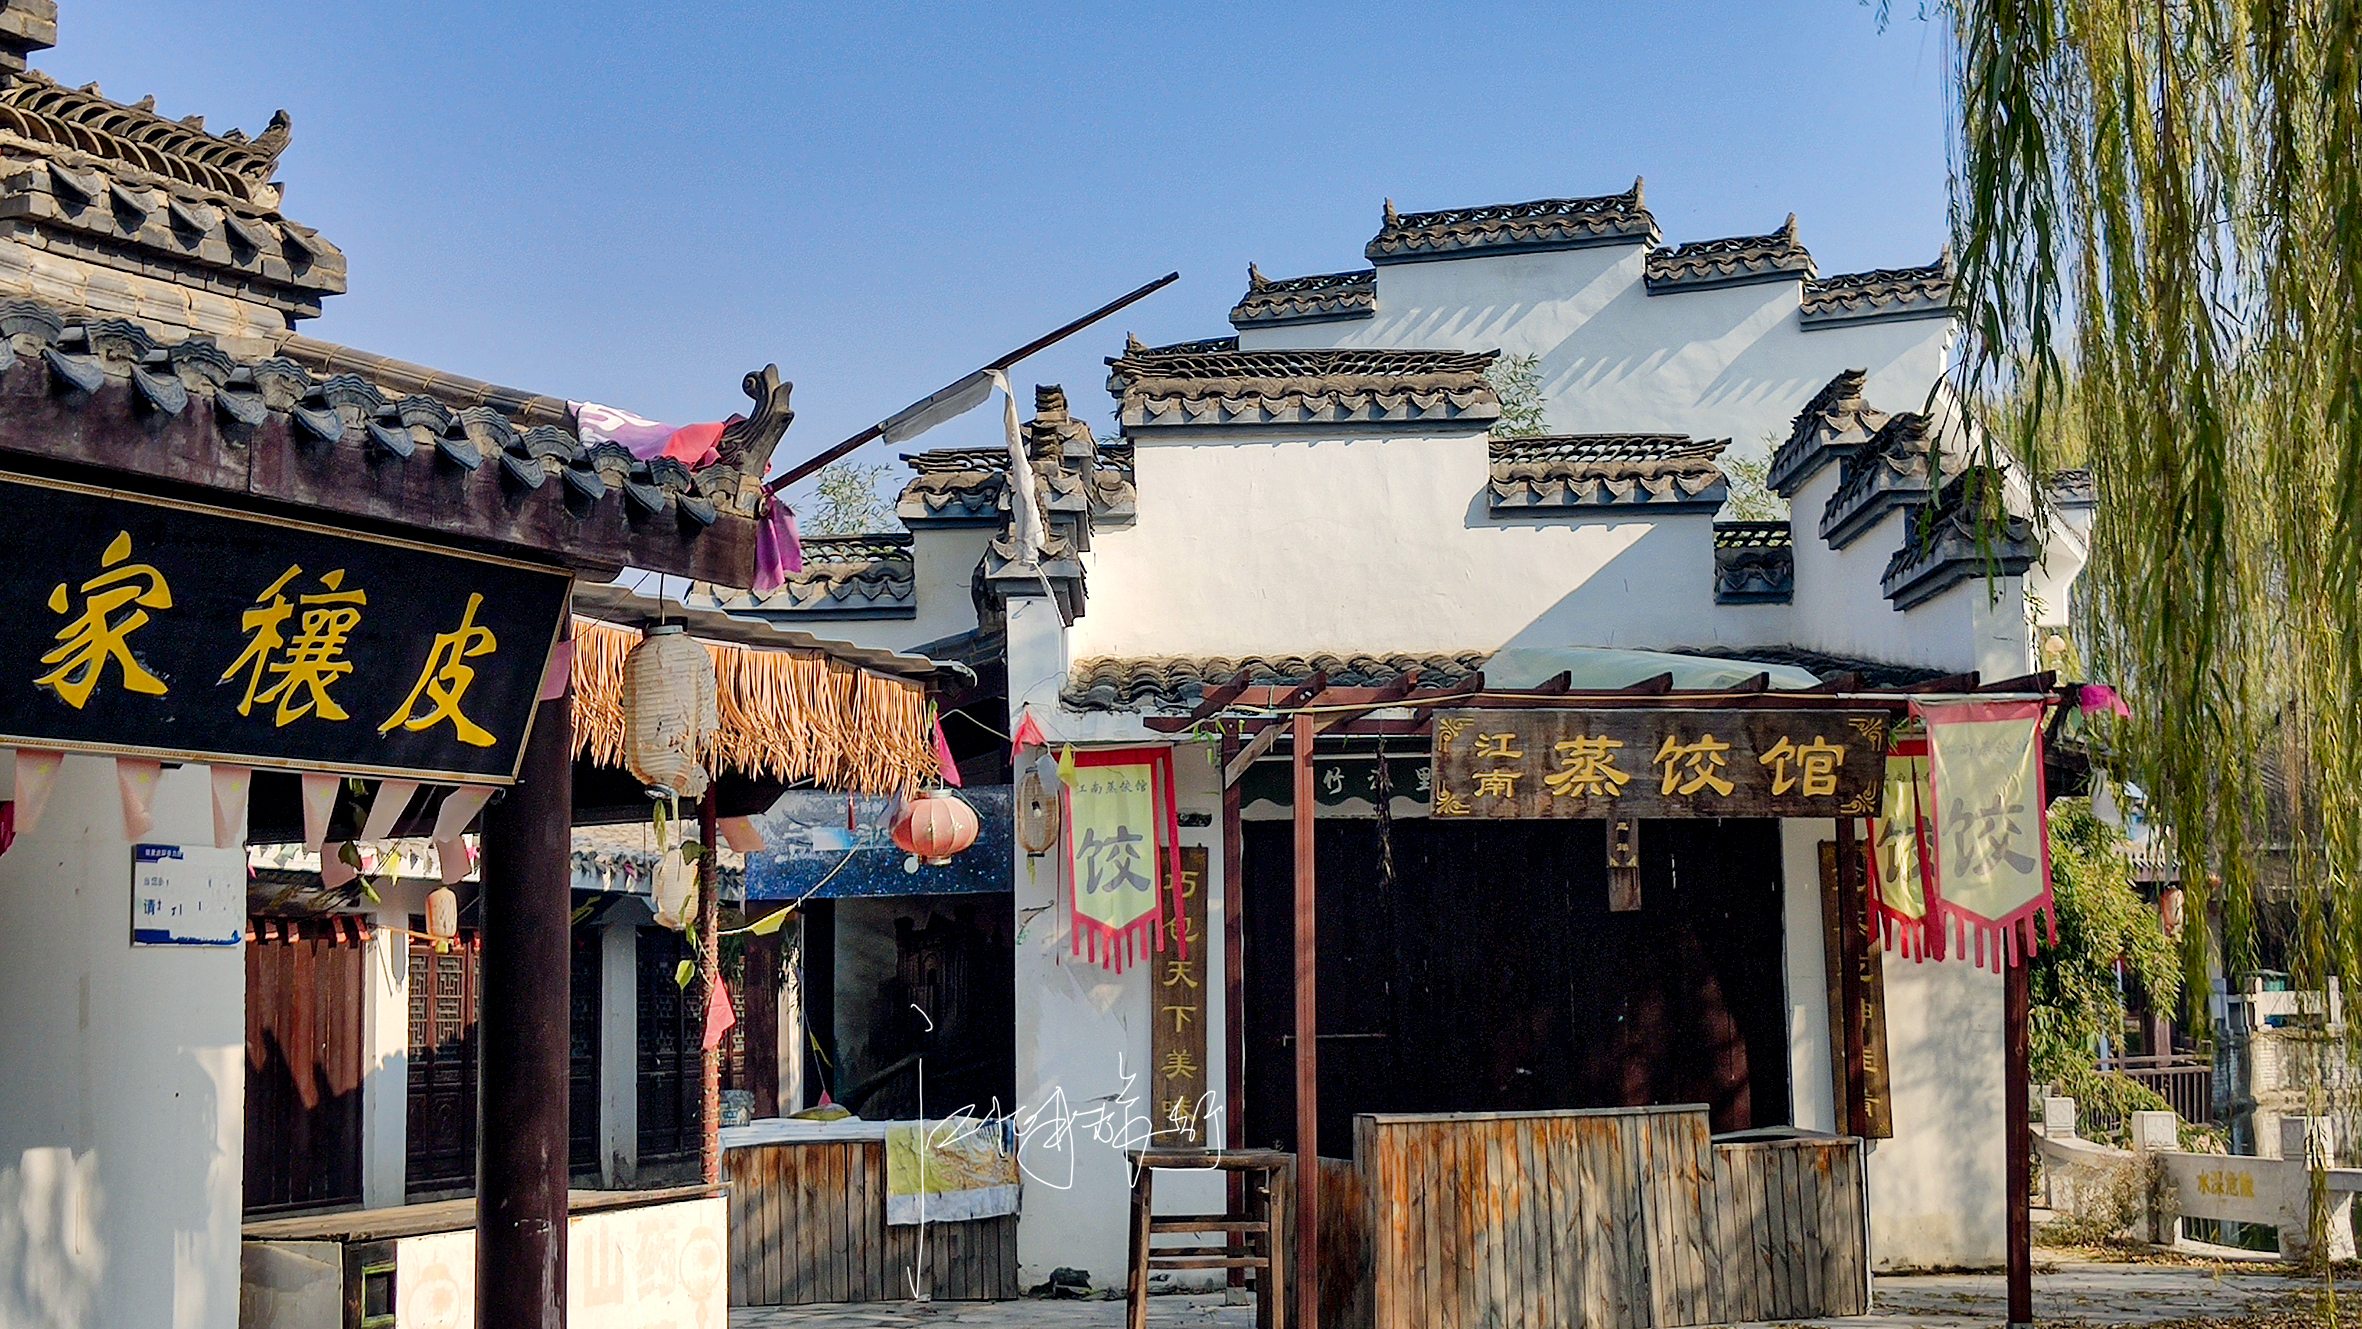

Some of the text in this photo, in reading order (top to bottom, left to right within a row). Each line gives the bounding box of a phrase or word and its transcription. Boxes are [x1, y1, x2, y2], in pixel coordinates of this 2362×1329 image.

[1471, 732, 1523, 797] 江南
[1544, 733, 1845, 797] 蒸饺馆
[1076, 825, 1151, 894] 饺
[1942, 794, 2036, 878] 饺
